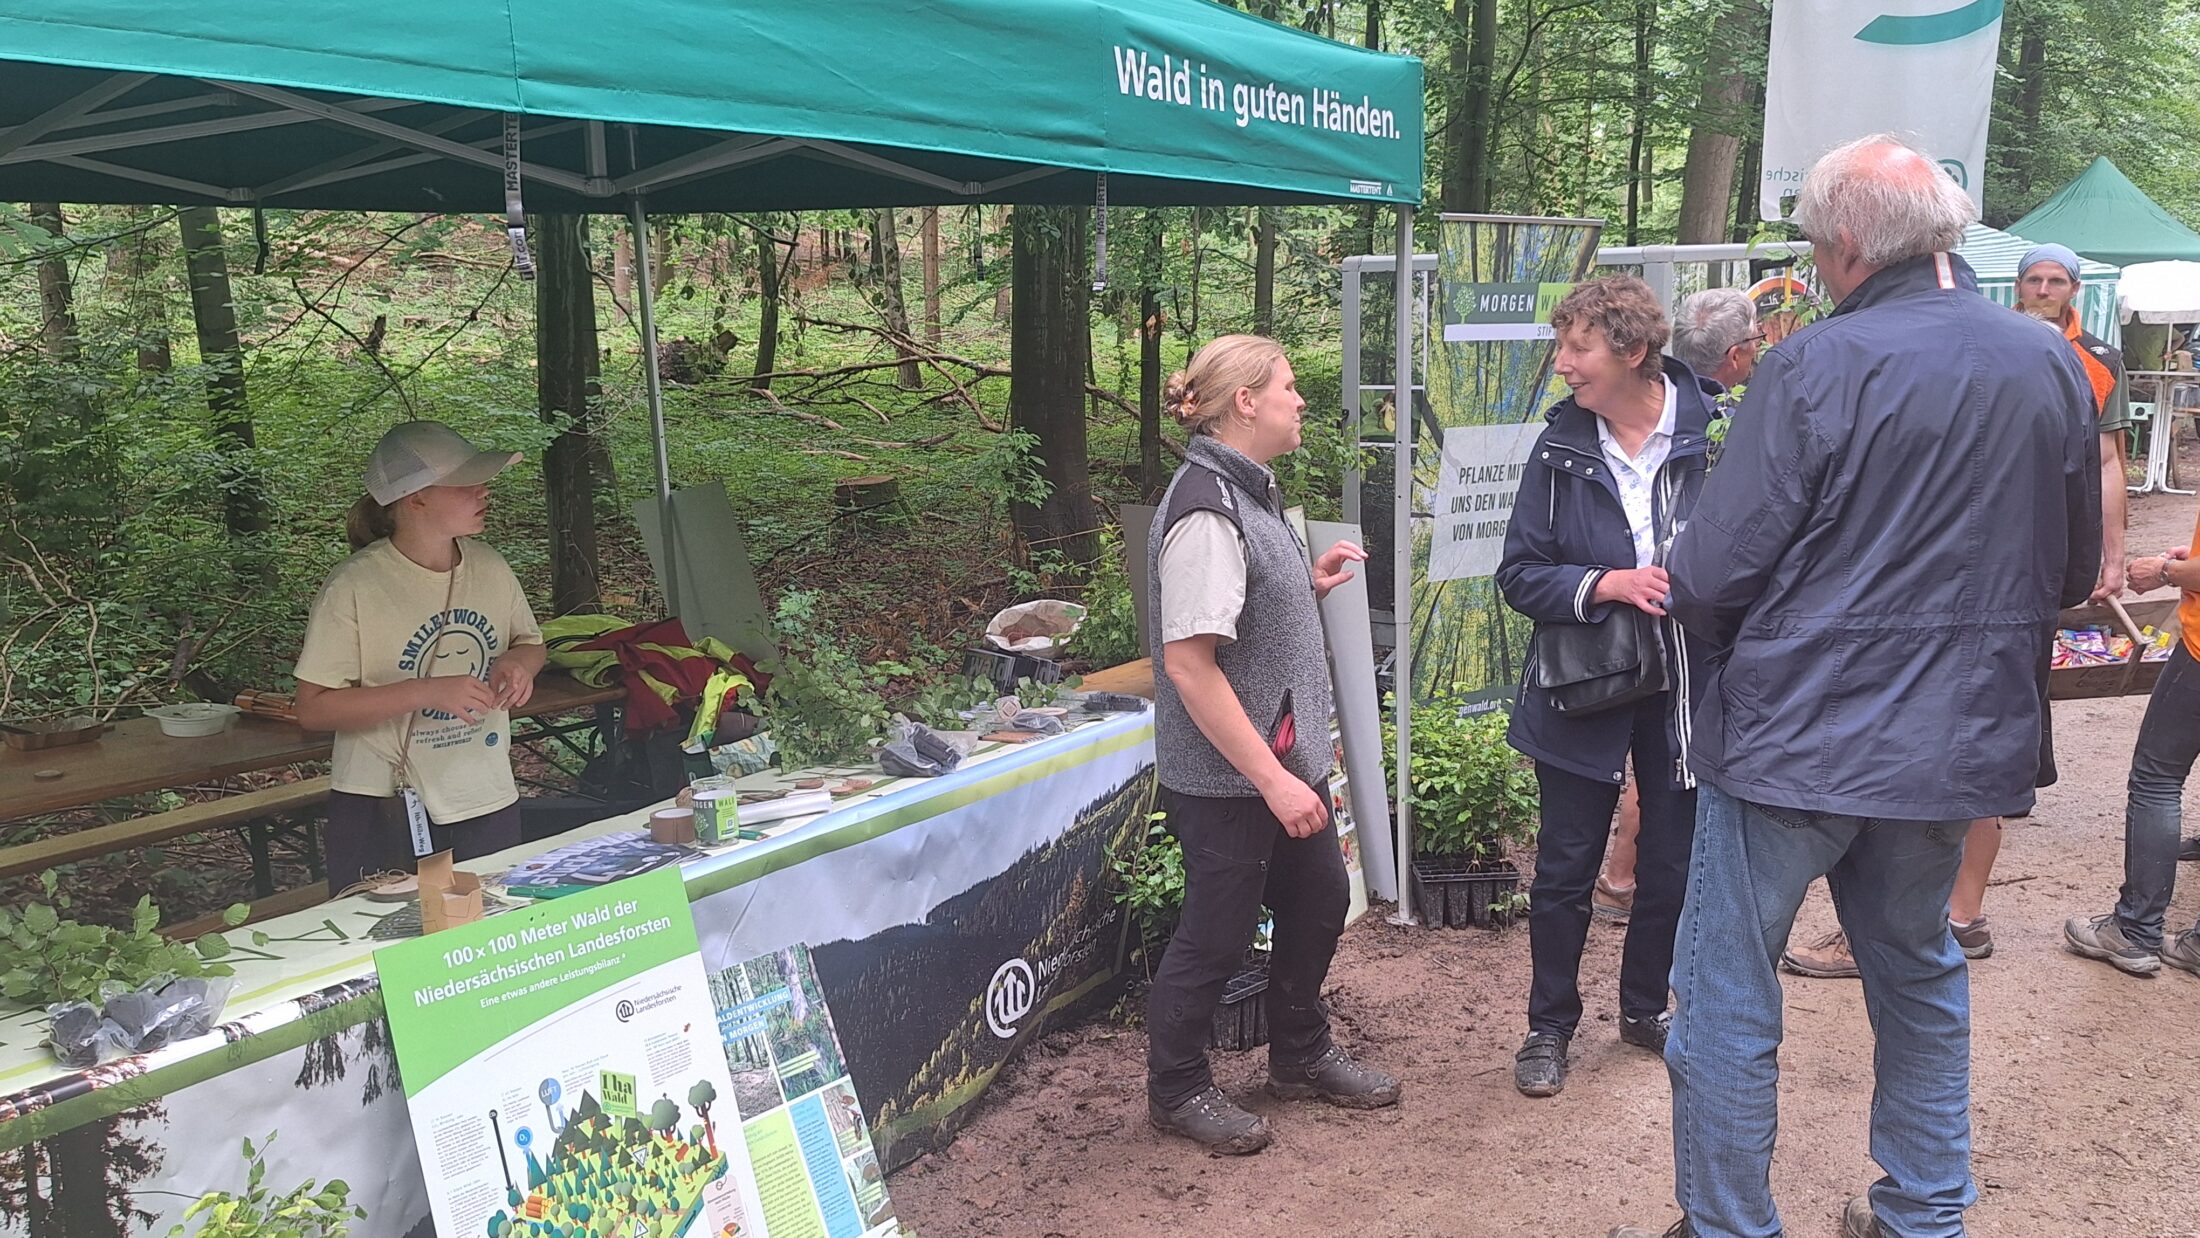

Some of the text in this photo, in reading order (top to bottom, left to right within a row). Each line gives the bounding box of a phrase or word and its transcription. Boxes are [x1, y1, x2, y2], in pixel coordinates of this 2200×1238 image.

[1114, 46, 1400, 139] Wald in guten Händen.
[1350, 183, 1382, 195] MASTERTENT
[1480, 294, 1563, 312] MORGEN WA
[1459, 463, 1528, 485] PFLANZE MIT
[1451, 491, 1514, 514] UNS DEN WA
[1453, 520, 1506, 542] VON MORG
[447, 732, 462, 740] and
[443, 946, 474, 968] 100
[488, 933, 517, 957] 100
[521, 920, 568, 946] Meter
[572, 905, 611, 930] Wald
[615, 899, 639, 918] der
[414, 916, 672, 1007] Niedersächsischen Landesforsten
[480, 996, 500, 1008] Eine
[501, 987, 528, 1001] etwas
[529, 976, 559, 993] andere
[634, 985, 682, 1006] Niedersächsische
[635, 995, 677, 1014] Landesforsten
[729, 1020, 765, 1040] MORGEN
[611, 1074, 632, 1095] ha
[602, 1090, 628, 1105] Wald
